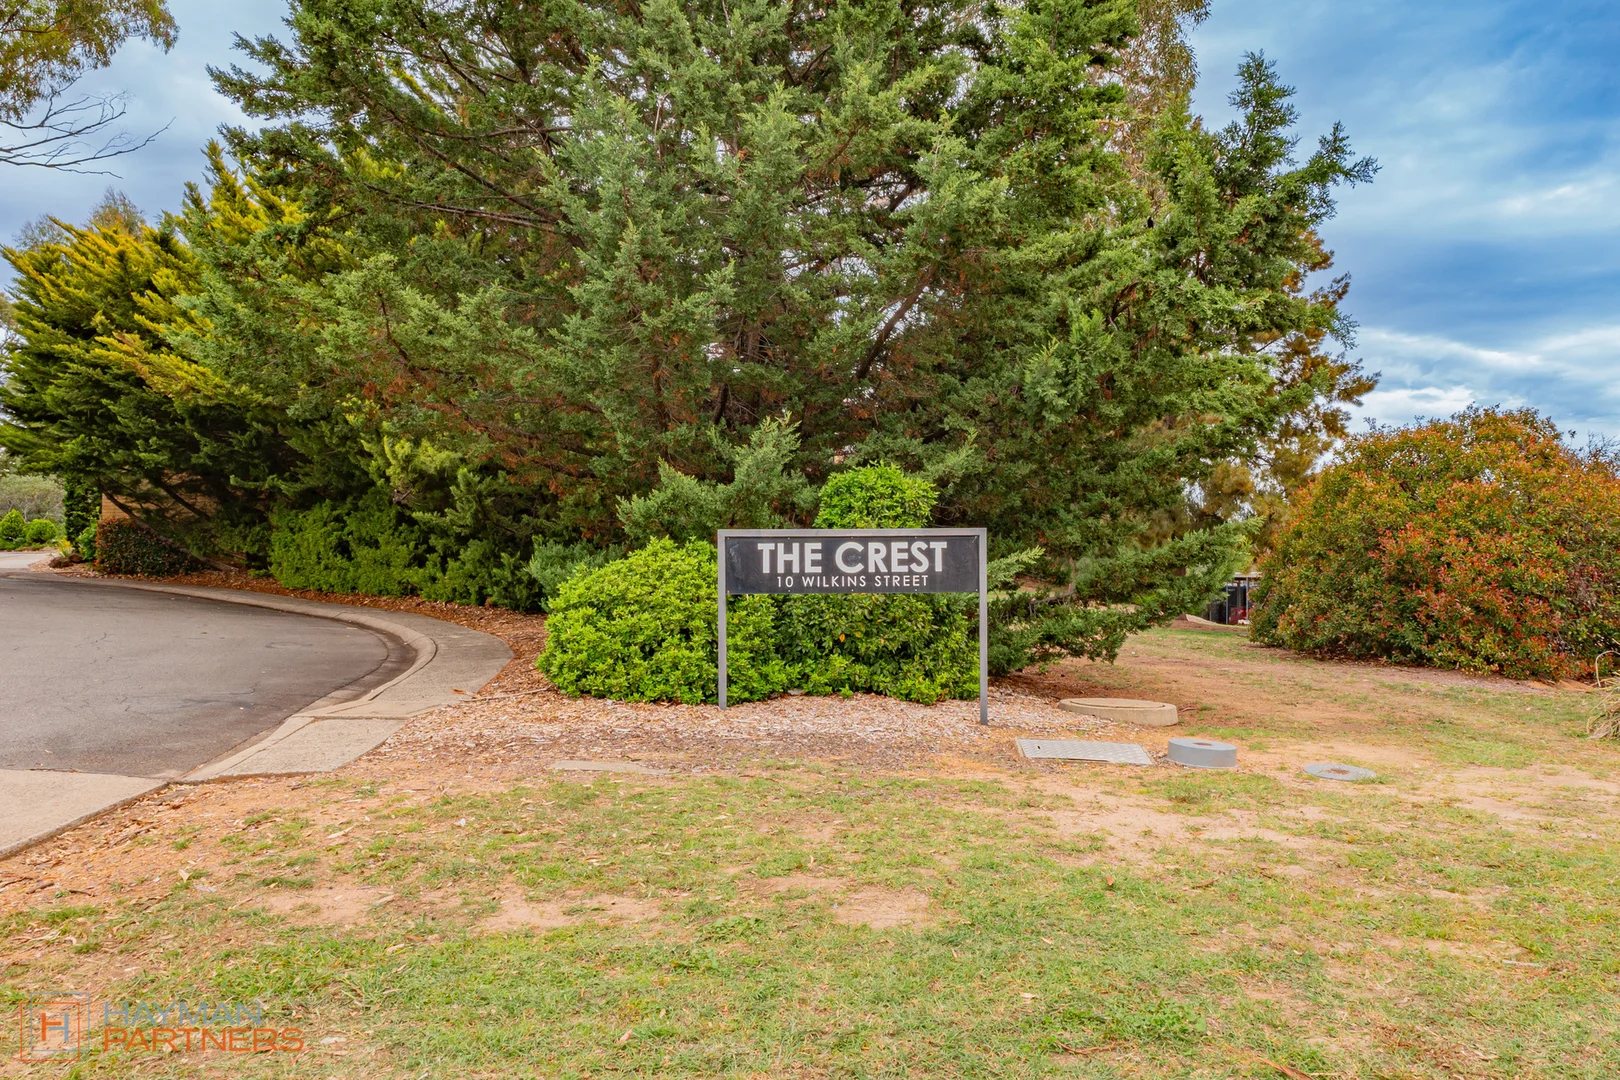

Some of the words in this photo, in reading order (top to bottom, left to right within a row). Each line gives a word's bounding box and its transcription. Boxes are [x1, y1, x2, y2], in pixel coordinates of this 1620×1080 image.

[757, 542, 822, 574] THE
[834, 541, 948, 573] CREST
[776, 575, 794, 588] 10
[801, 575, 867, 588] WILKINS
[874, 574, 929, 587] STREET
